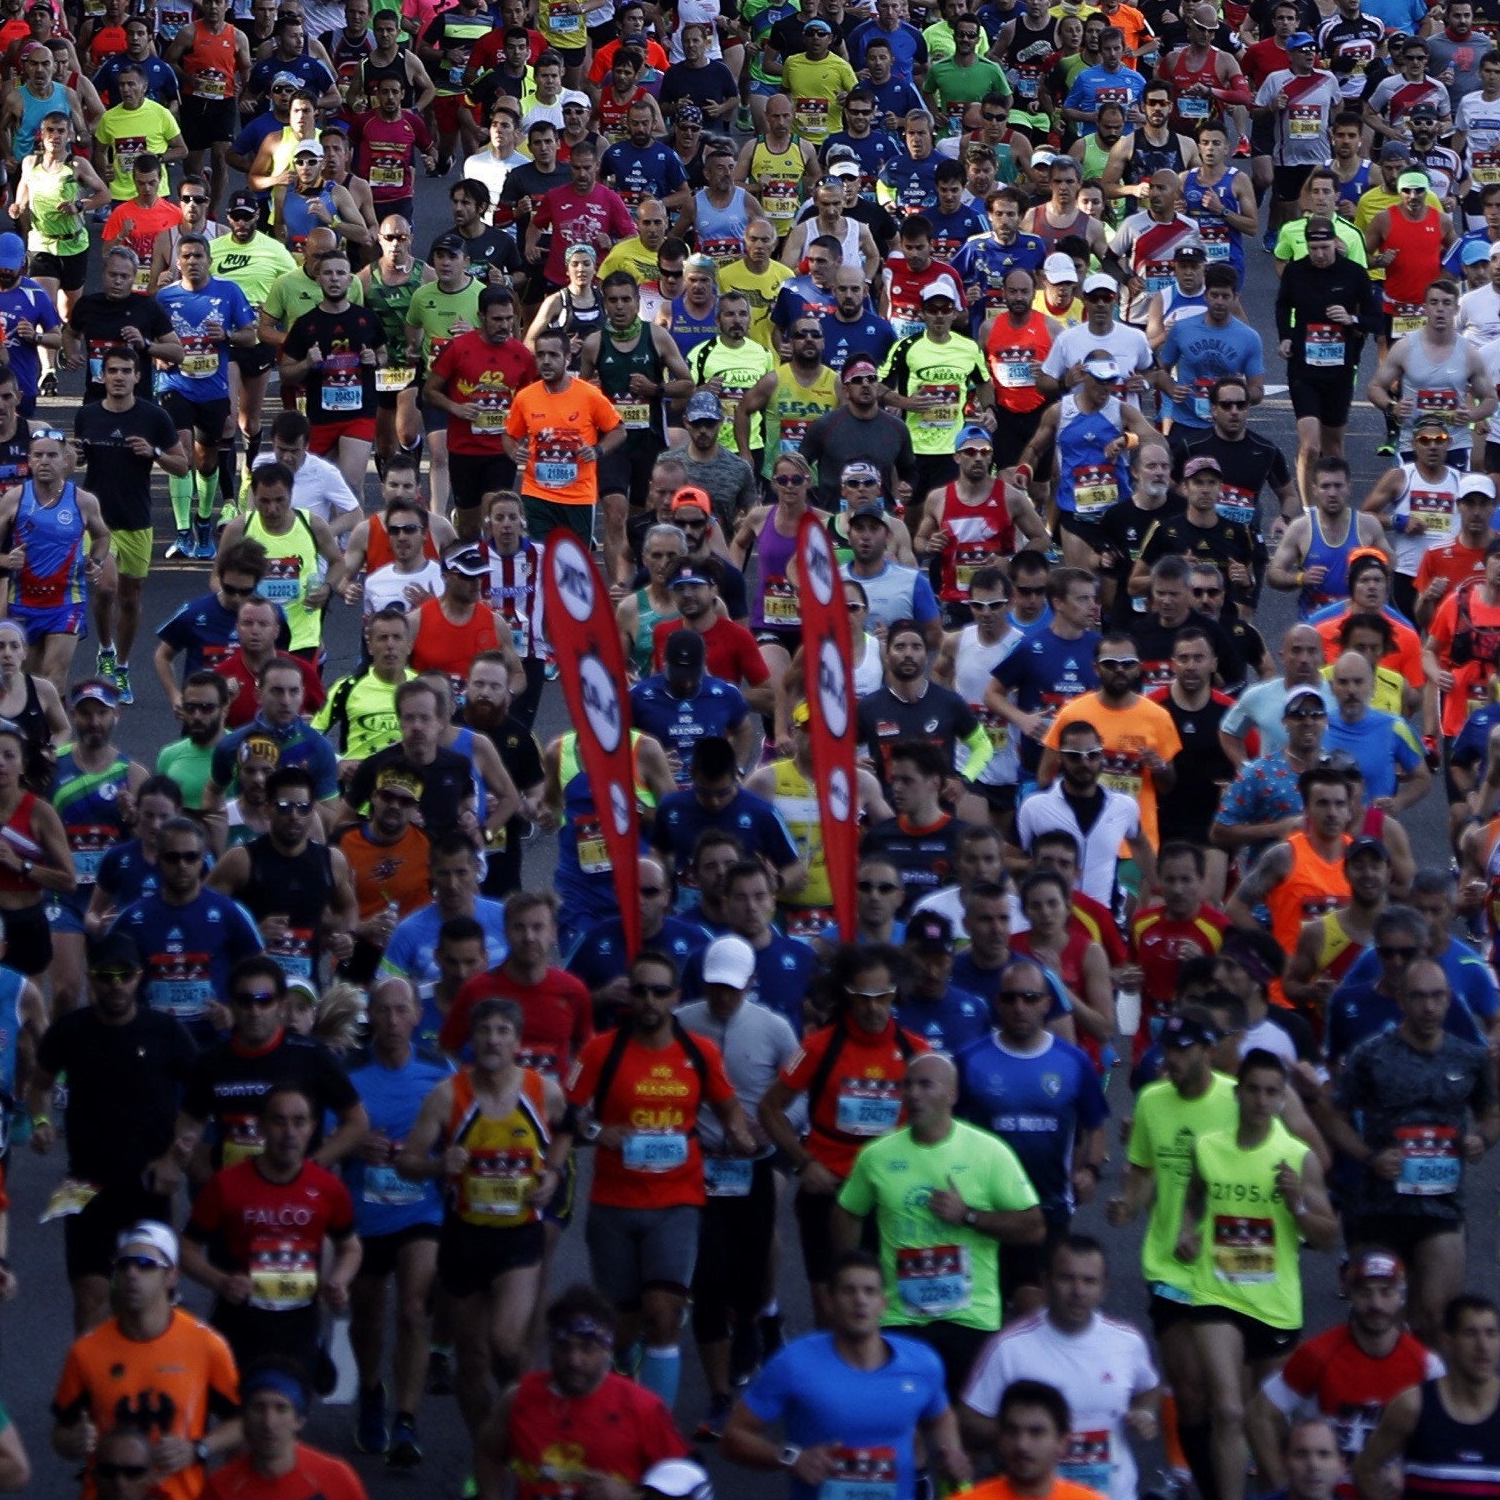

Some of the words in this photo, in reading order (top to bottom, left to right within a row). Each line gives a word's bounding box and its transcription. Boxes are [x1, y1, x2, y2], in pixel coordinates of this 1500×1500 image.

[1189, 339, 1238, 361] BROOKLYN
[478, 371, 505, 386] 42
[243, 1209, 312, 1226] FALCO
